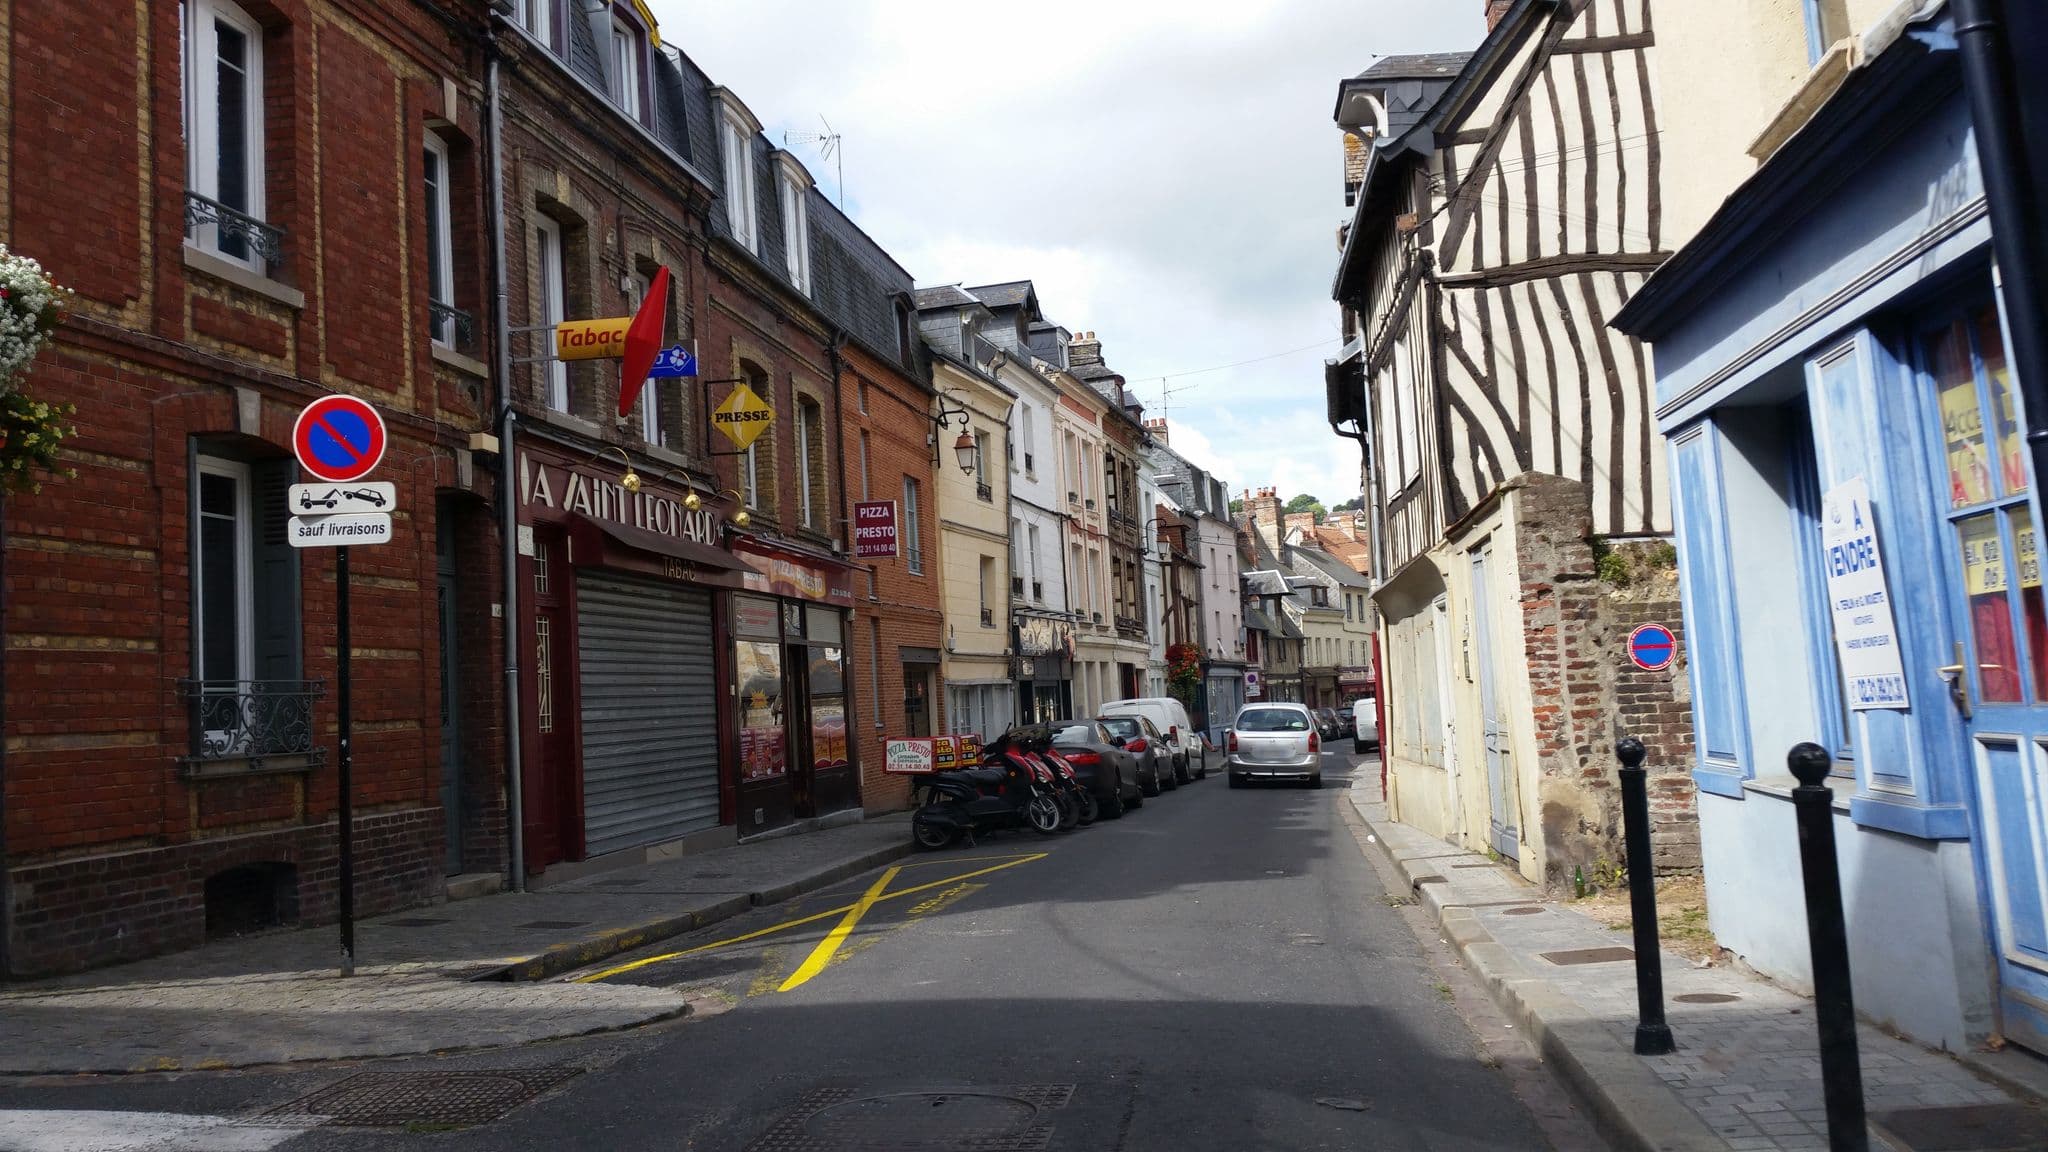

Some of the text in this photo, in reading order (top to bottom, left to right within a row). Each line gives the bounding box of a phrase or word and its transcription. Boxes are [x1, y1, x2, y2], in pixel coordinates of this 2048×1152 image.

[558, 327, 624, 348] Tabac
[715, 410, 770, 423] PRESSE
[860, 506, 890, 518] PIZZA
[1851, 499, 1864, 532] A
[298, 522, 385, 537] sauf livraisons
[856, 526, 895, 538] PRESTO
[1825, 535, 1876, 578] VENDRE
[663, 556, 696, 582] TABAC
[887, 742, 907, 758] PIZZA
[908, 741, 931, 758] PRESTO
